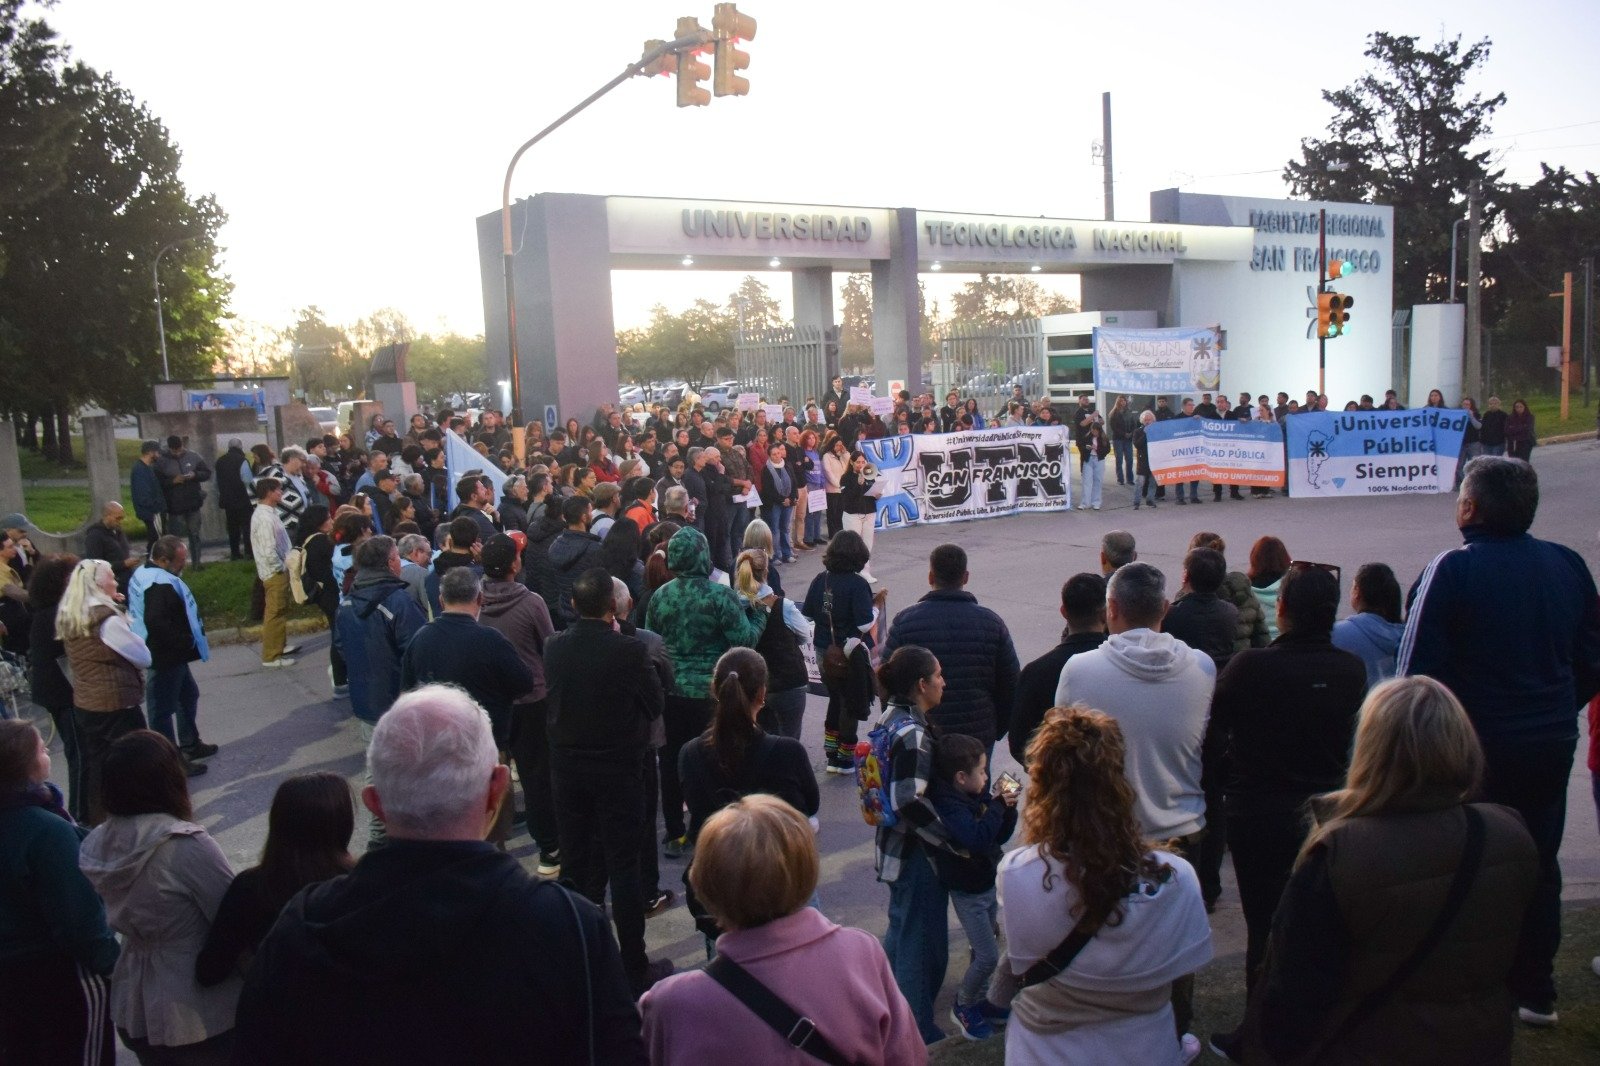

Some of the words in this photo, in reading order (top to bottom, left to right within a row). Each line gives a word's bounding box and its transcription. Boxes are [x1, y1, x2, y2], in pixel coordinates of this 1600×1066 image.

[682, 209, 872, 242] UNIVERSIDAD
[925, 220, 1077, 249] TECNOLOGICA
[1093, 228, 1187, 254] NACIONAL
[1250, 209, 1320, 234] FACULTAD
[1324, 214, 1385, 238] REGIONAL
[1250, 245, 1285, 271] SAN
[1122, 380, 1187, 390] FRANCISCO
[1334, 410, 1467, 435] ¡Universidad
[1172, 446, 1225, 457] UNIVERDAD
[1228, 449, 1265, 460] PÚBLICA
[1363, 436, 1436, 455] Pública
[919, 443, 1066, 508] UTN
[927, 470, 968, 489] SAN
[971, 461, 1062, 484] FRANCISCO
[1355, 463, 1437, 481] Siempre
